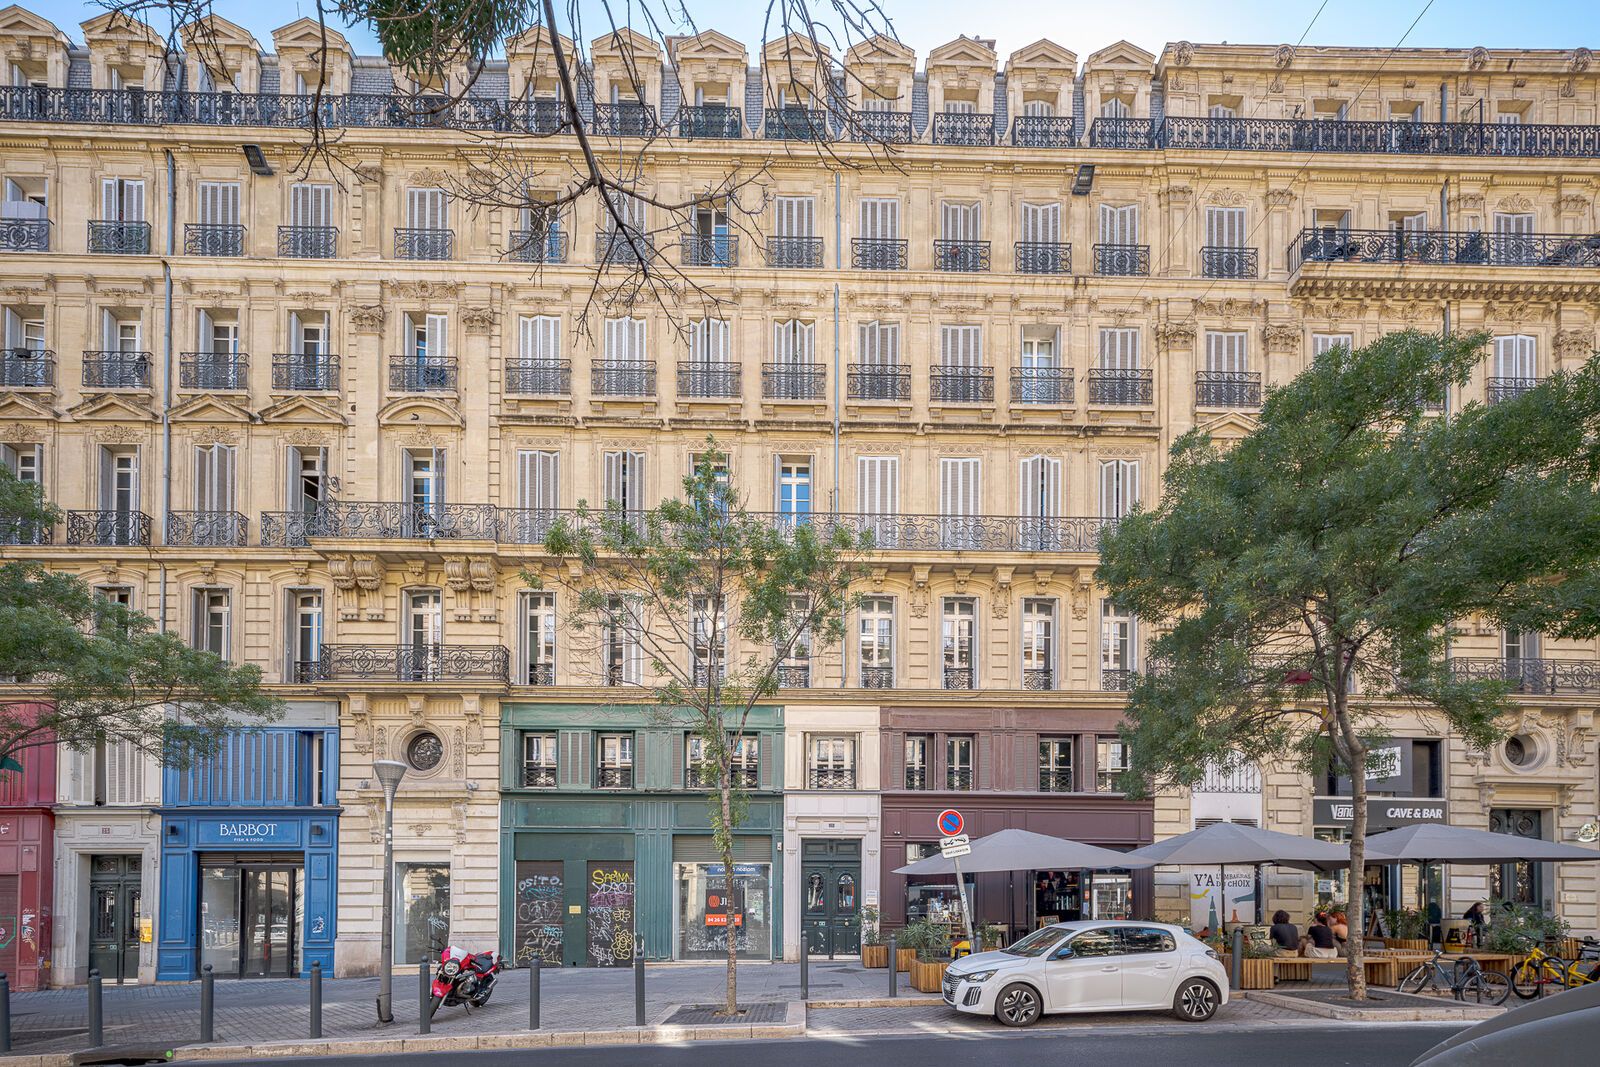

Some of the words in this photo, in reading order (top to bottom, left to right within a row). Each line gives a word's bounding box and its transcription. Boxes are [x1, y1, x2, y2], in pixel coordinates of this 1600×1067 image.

[1386, 808, 1413, 818] CAVE
[1413, 808, 1421, 819] &
[1422, 808, 1443, 819] BAR
[219, 823, 278, 836] BARBOT
[1227, 880, 1251, 888] CHOIX
